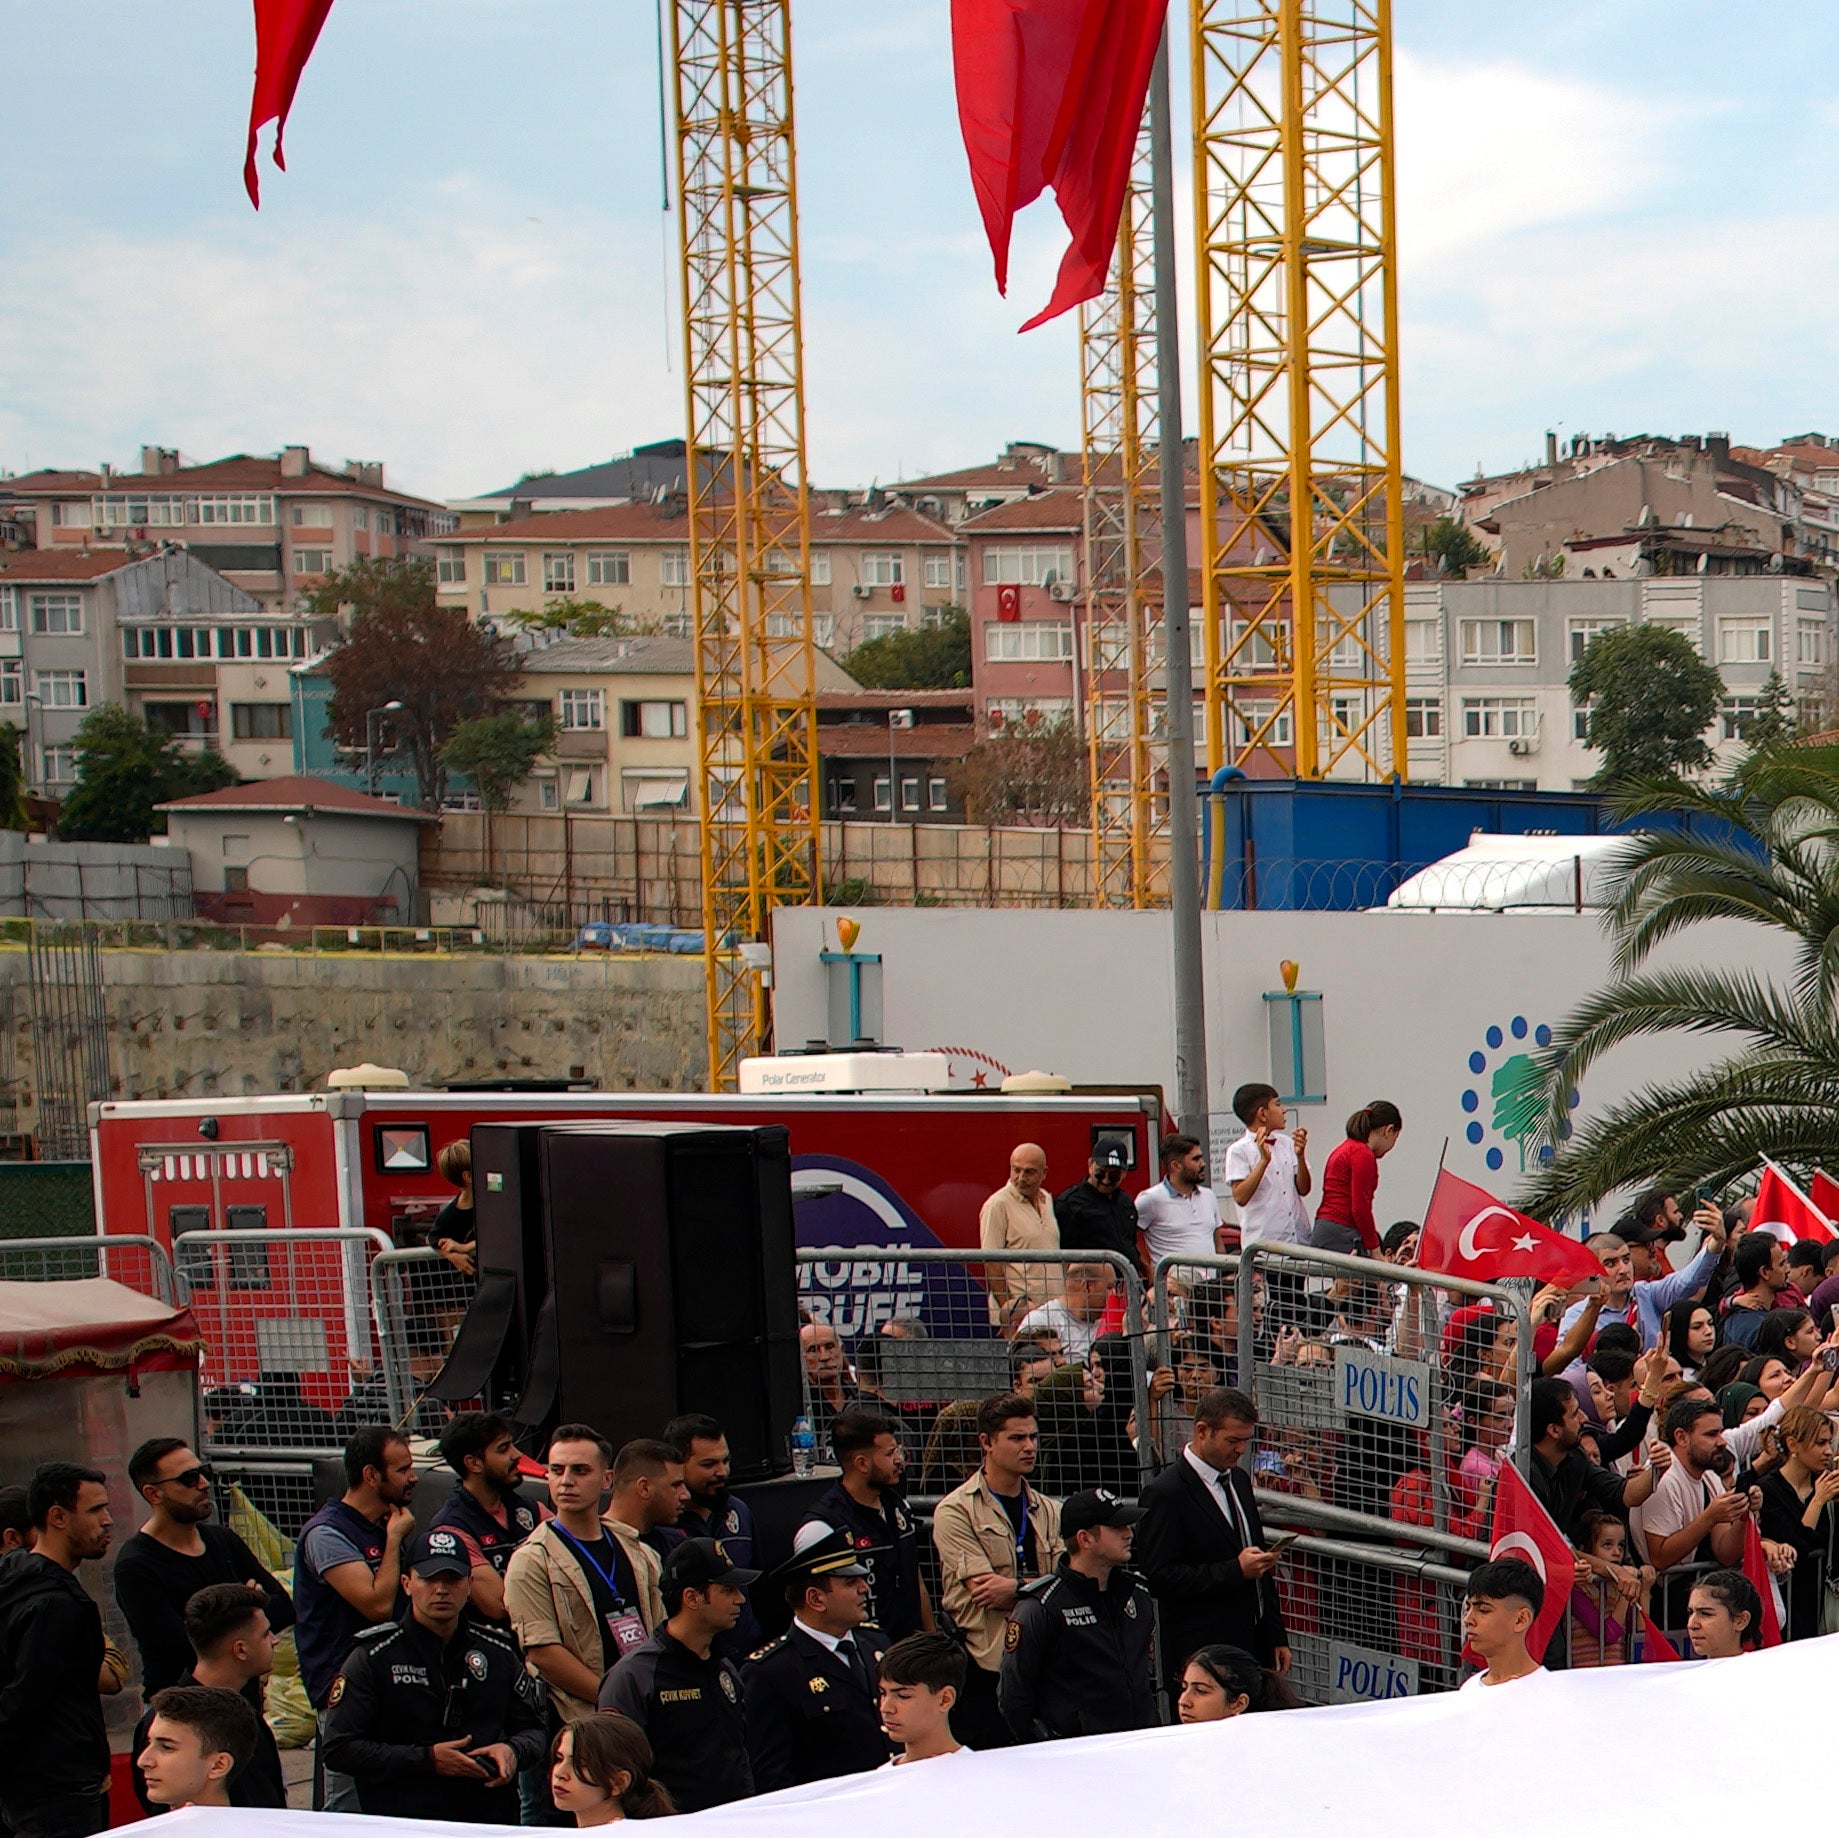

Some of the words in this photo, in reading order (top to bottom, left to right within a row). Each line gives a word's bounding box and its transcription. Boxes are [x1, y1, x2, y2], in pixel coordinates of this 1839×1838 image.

[762, 1073, 784, 1085] Polar
[785, 1072, 827, 1085] Generator
[1336, 1656, 1409, 1698] POLİS
